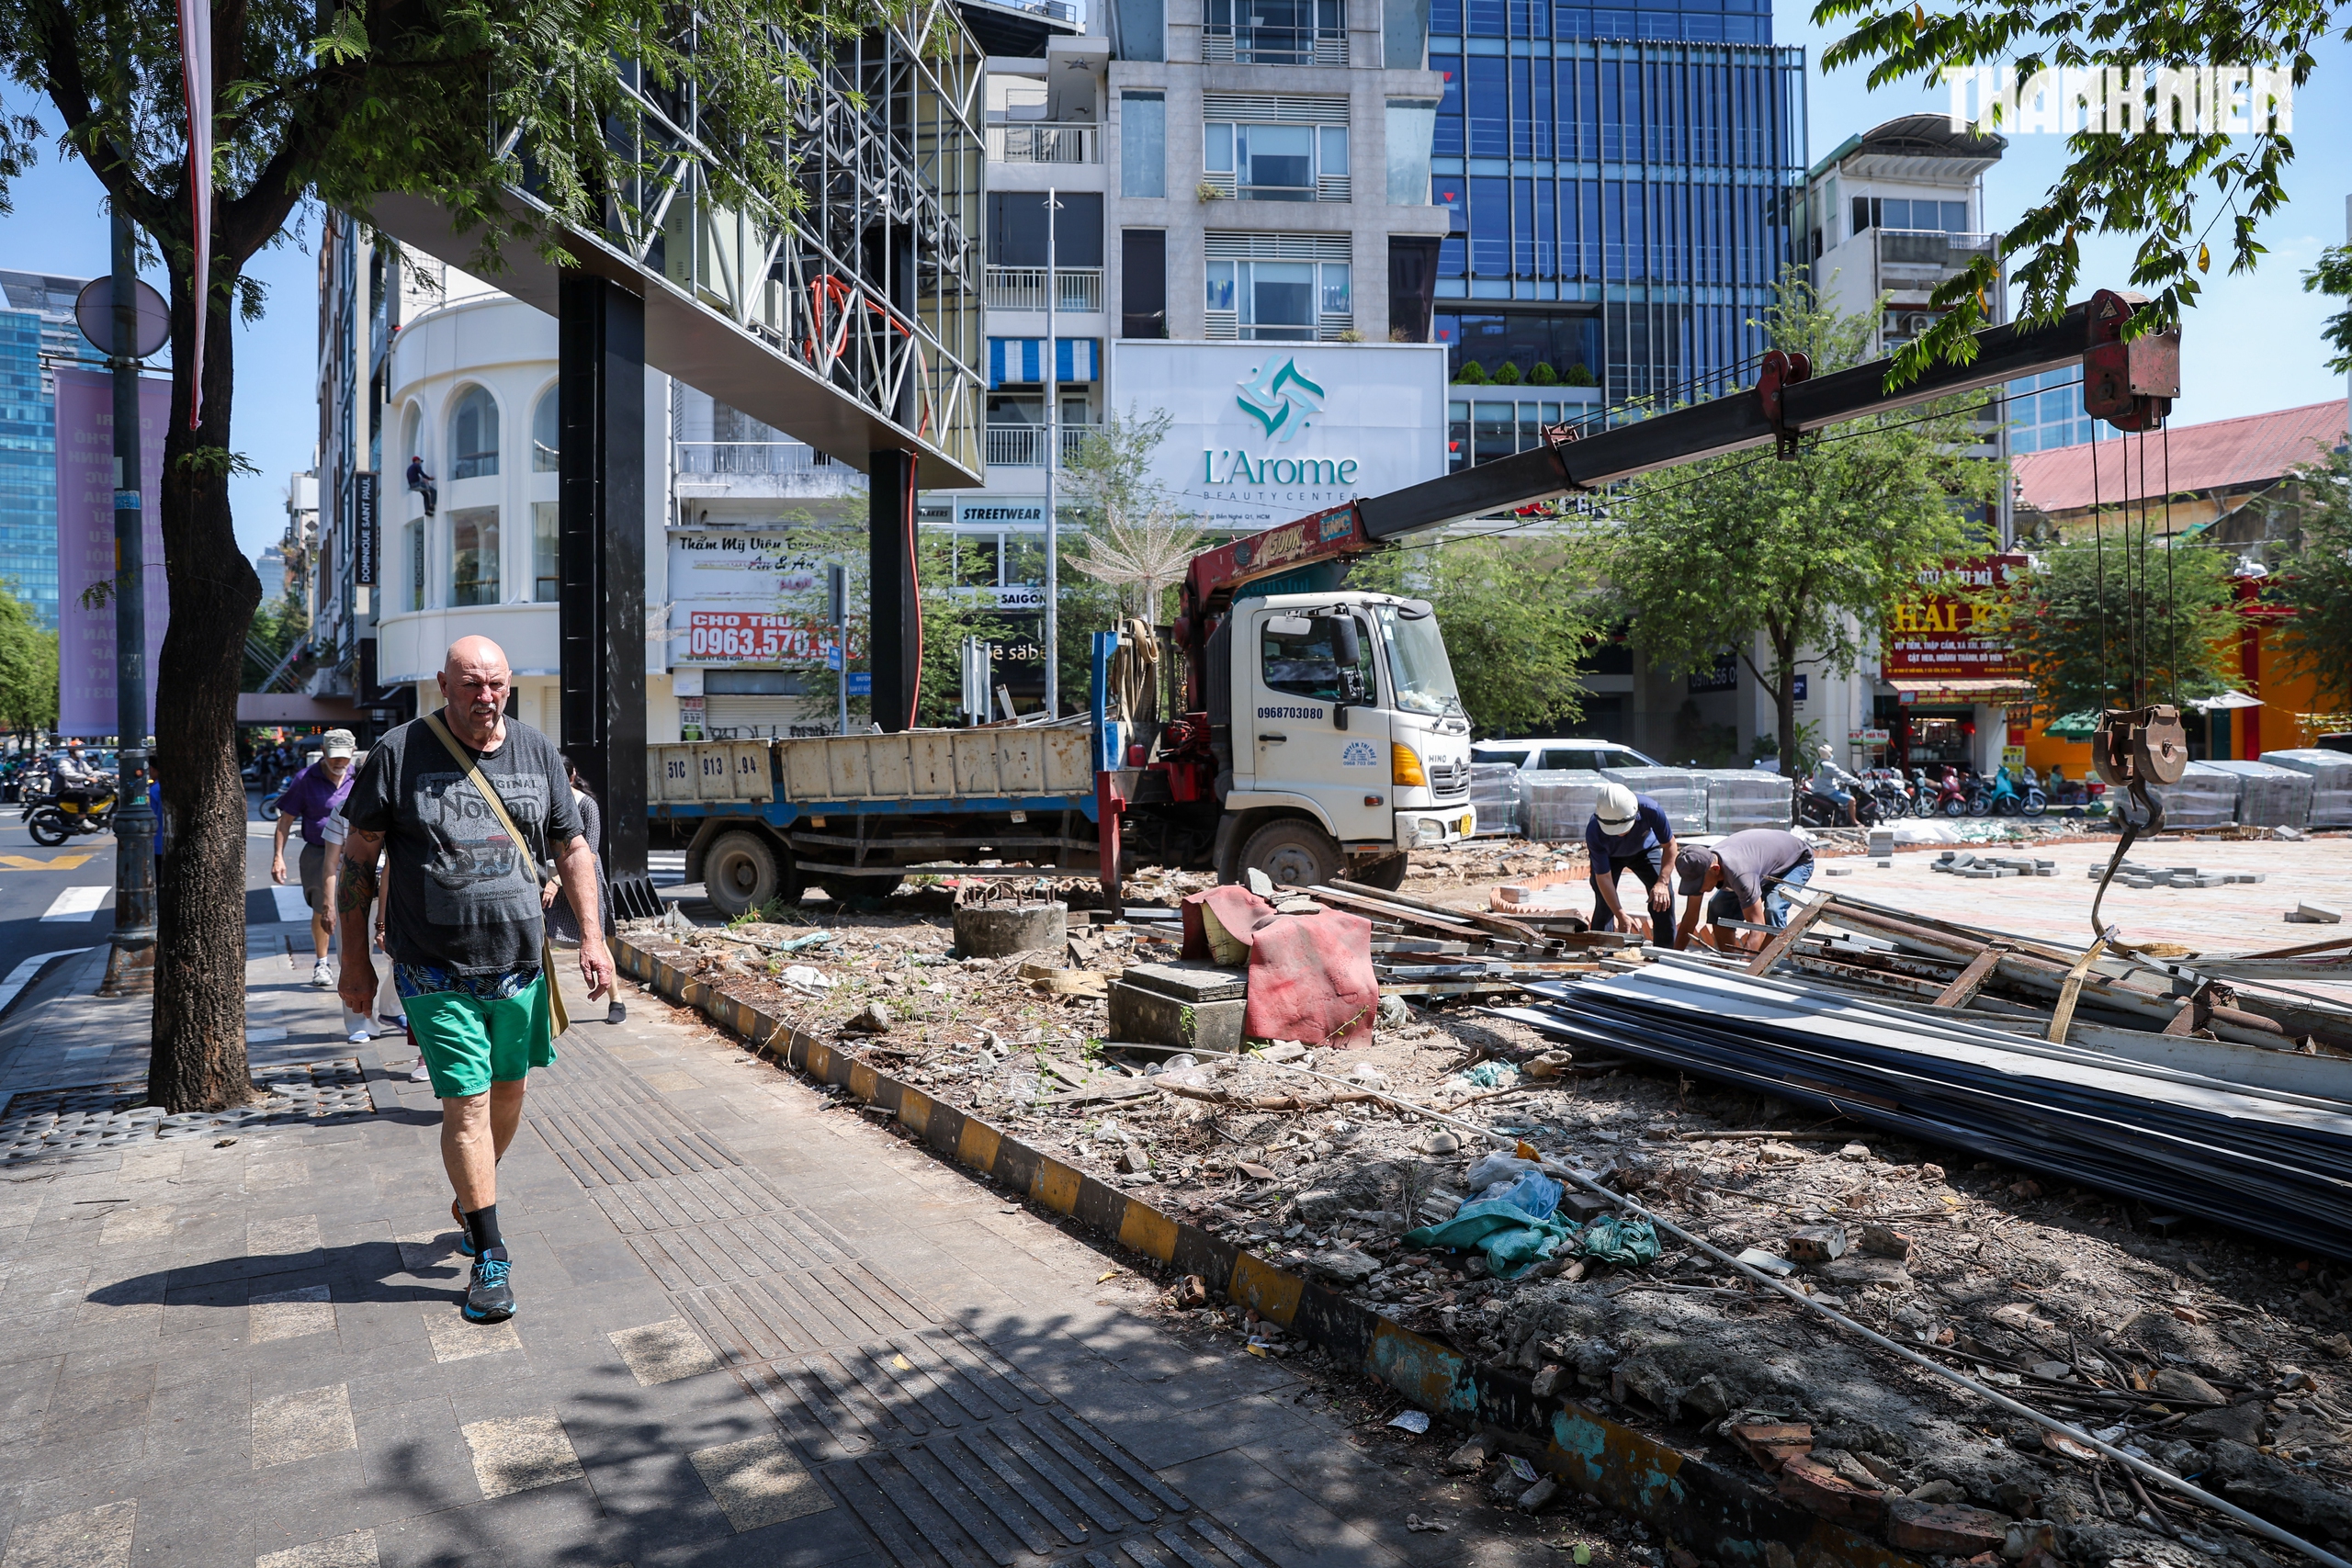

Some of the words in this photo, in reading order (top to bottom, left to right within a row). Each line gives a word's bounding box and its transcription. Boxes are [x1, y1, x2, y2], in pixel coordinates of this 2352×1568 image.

[1204, 449, 1359, 486] L'Arome
[361, 477, 370, 500] PAUL
[1204, 491, 1277, 501] BEAUTY
[1286, 491, 1359, 502] CENTER
[361, 501, 370, 527] SAINT
[964, 508, 1041, 520] STREETWEAR
[1321, 514, 1351, 537] UNIC
[679, 536, 718, 550] Thẩm
[722, 536, 745, 553] Mỹ
[1270, 525, 1304, 557] 500K
[361, 529, 370, 582] DOMINIQUE
[693, 615, 741, 626] CHO
[1894, 593, 1959, 633] HẢI
[1257, 706, 1323, 719] 0968703080
[667, 760, 685, 779] 51C
[703, 757, 723, 775] 913
[1429, 754, 1447, 763] HINO
